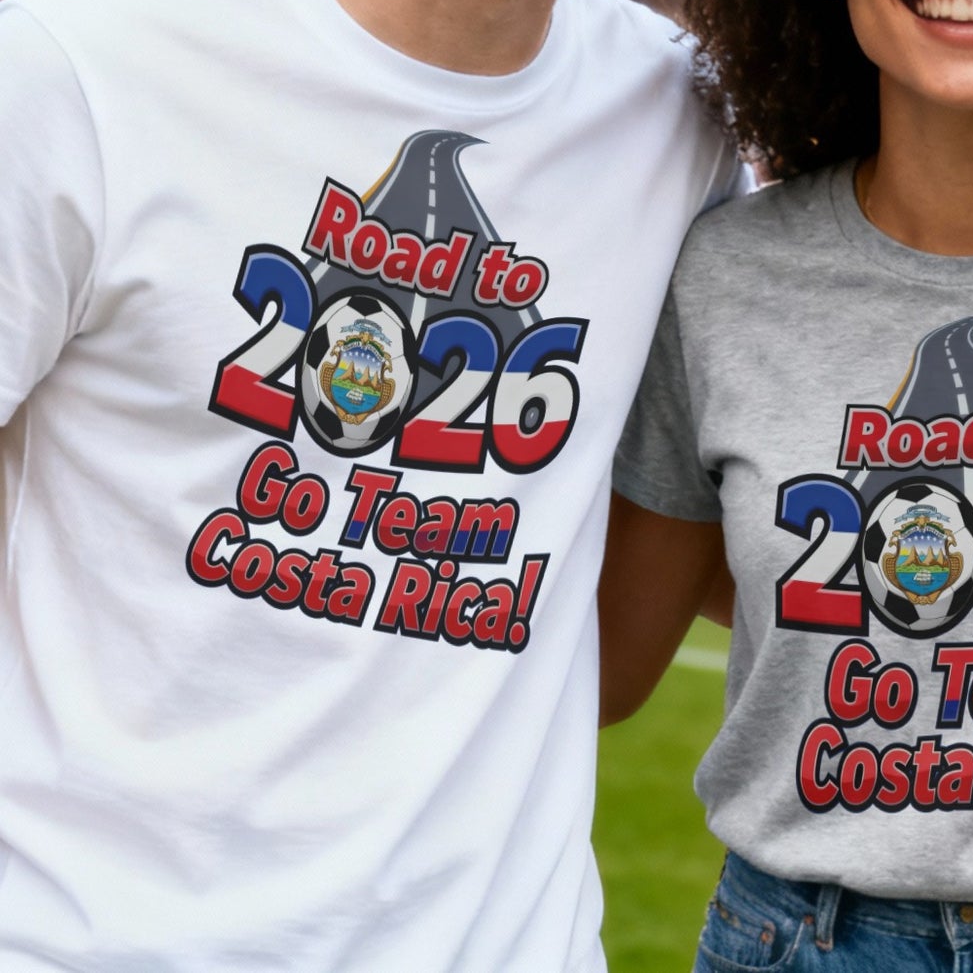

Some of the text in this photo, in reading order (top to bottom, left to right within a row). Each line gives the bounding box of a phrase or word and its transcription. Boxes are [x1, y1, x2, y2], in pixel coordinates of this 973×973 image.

[303, 176, 549, 307] Road to
[208, 243, 589, 474] 2026
[237, 440, 520, 563] Go Team
[186, 507, 550, 654] Costa Rica!
[825, 638, 918, 728] Go
